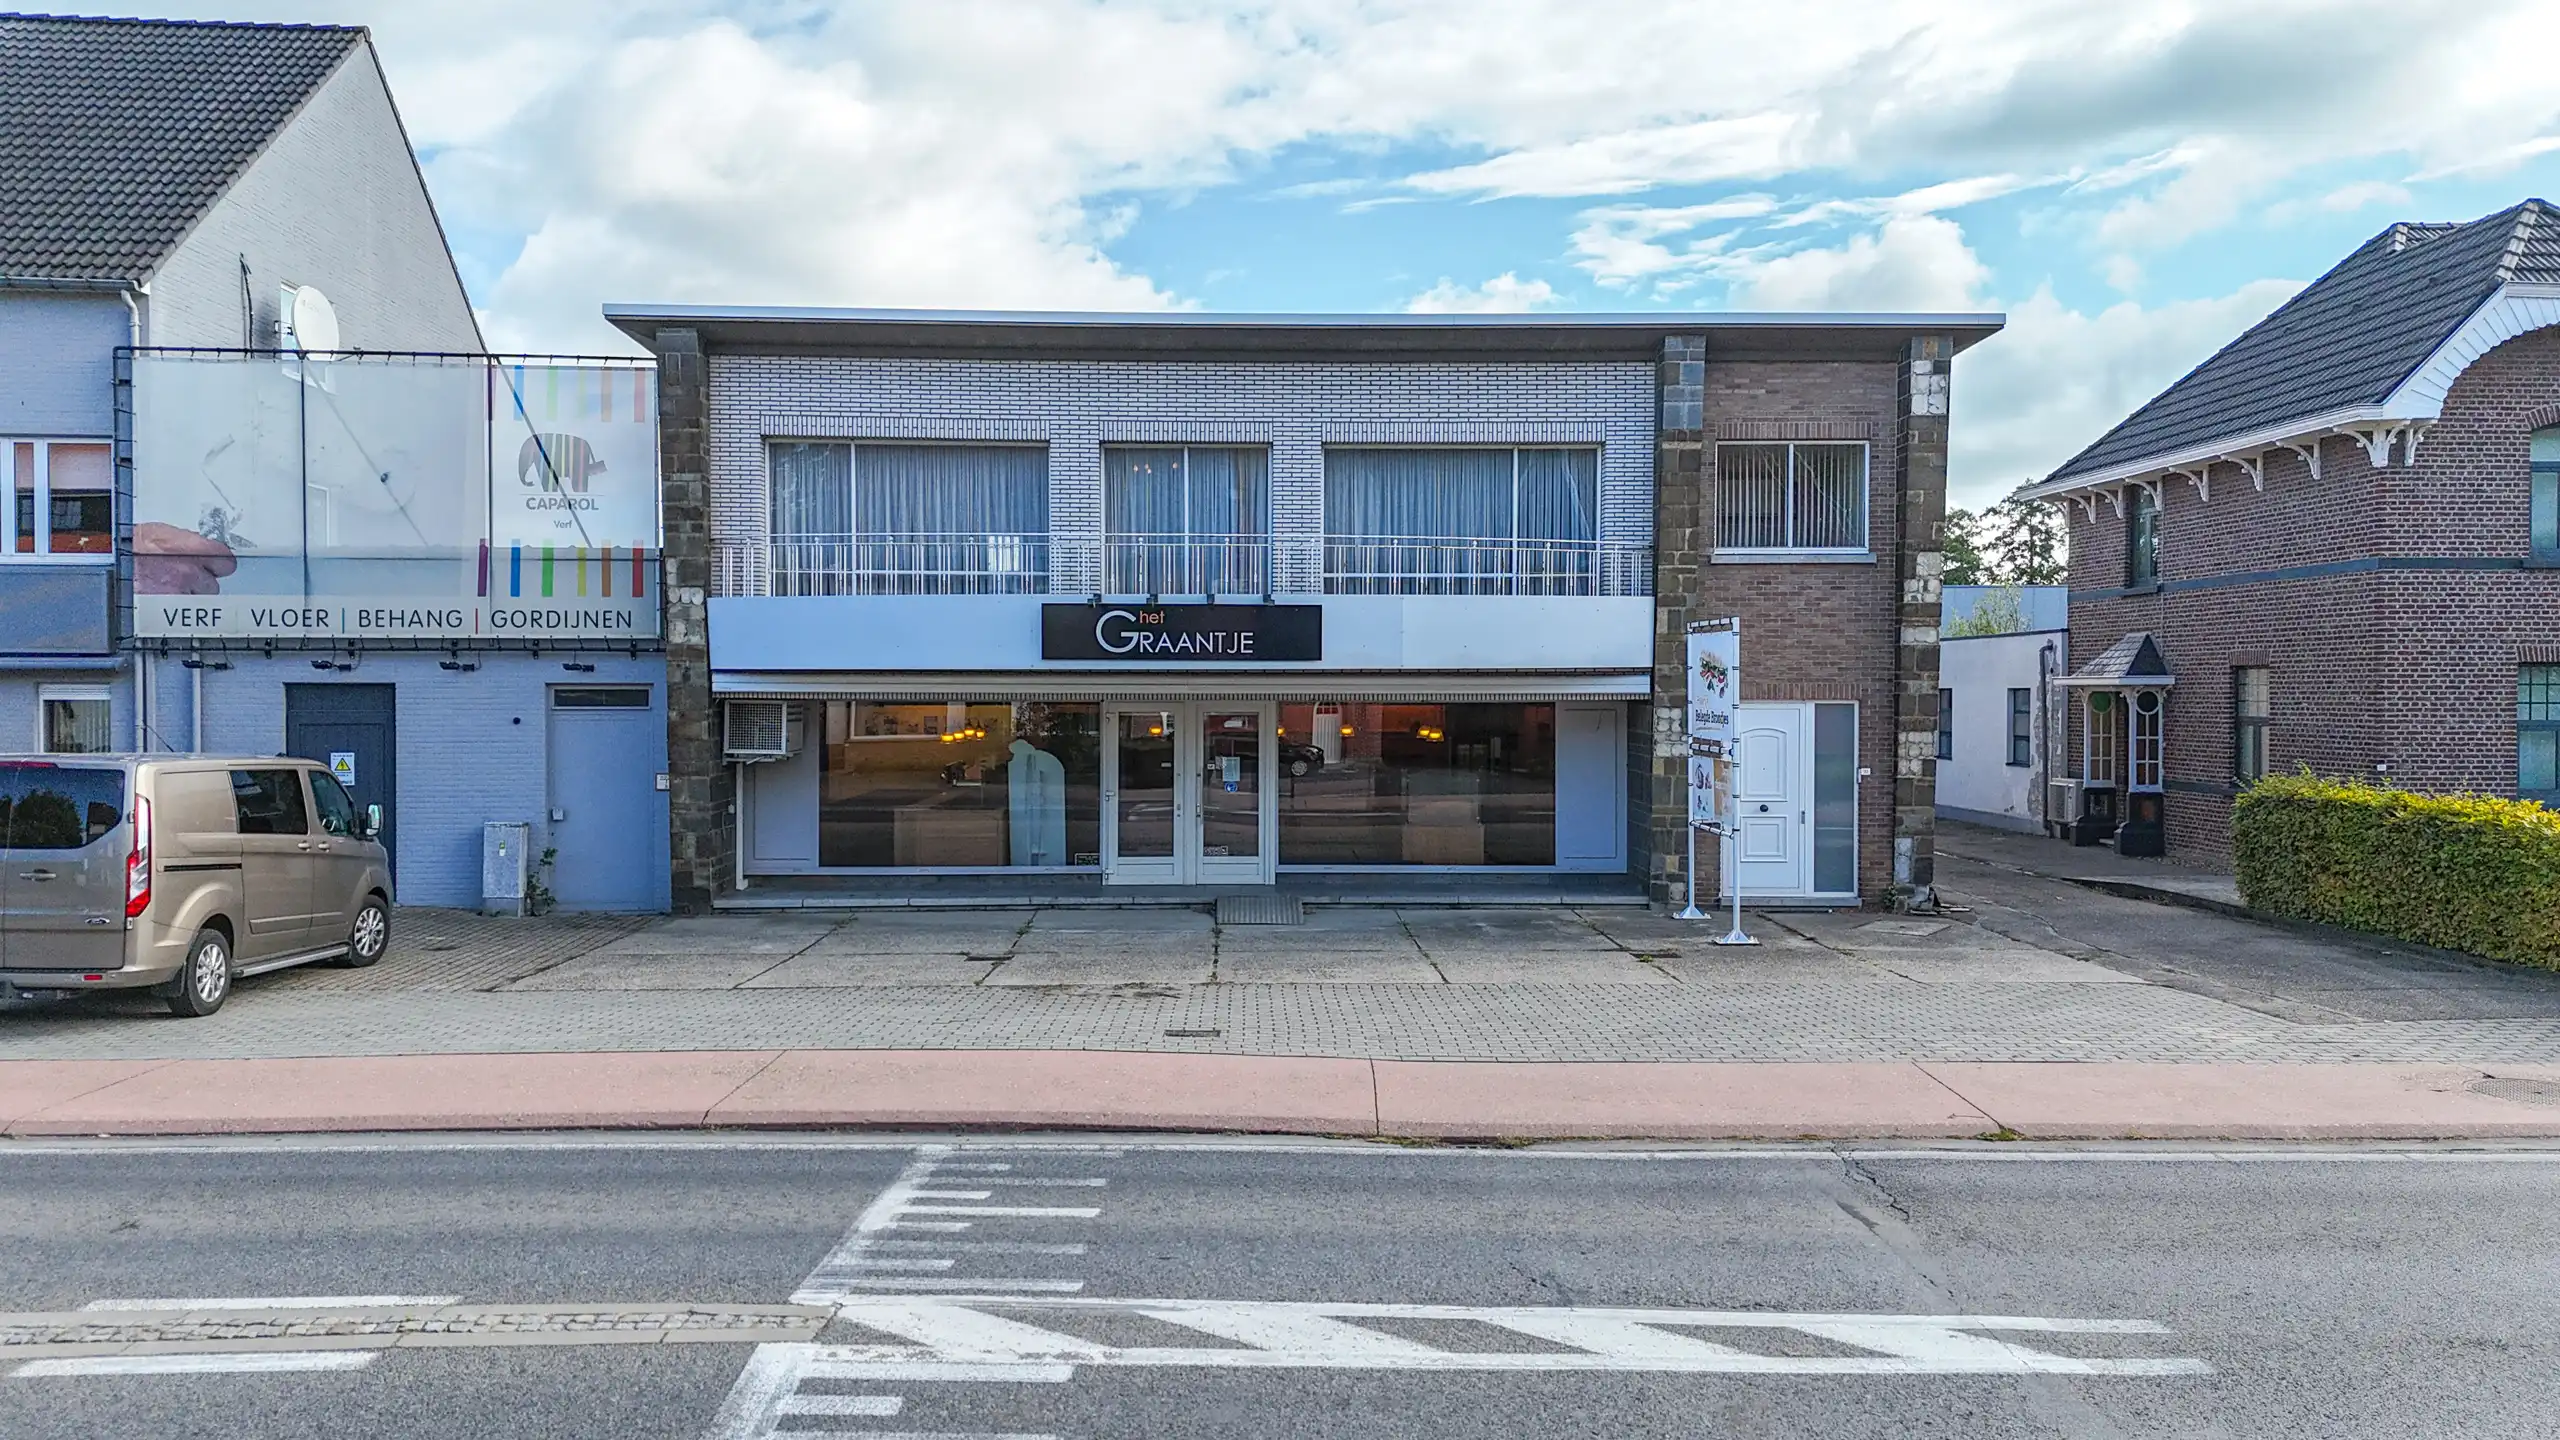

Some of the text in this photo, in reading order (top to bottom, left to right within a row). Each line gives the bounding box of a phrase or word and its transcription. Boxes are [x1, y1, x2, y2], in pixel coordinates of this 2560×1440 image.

[525, 497, 599, 511] CAPAROL
[553, 519, 573, 529] Verf
[163, 608, 632, 629] VERF VLOER BEHANG GORDIJNEN
[1139, 610, 1165, 624] het
[1095, 609, 1254, 654] GRAANTJE
[1695, 709, 1711, 726] Belegde
